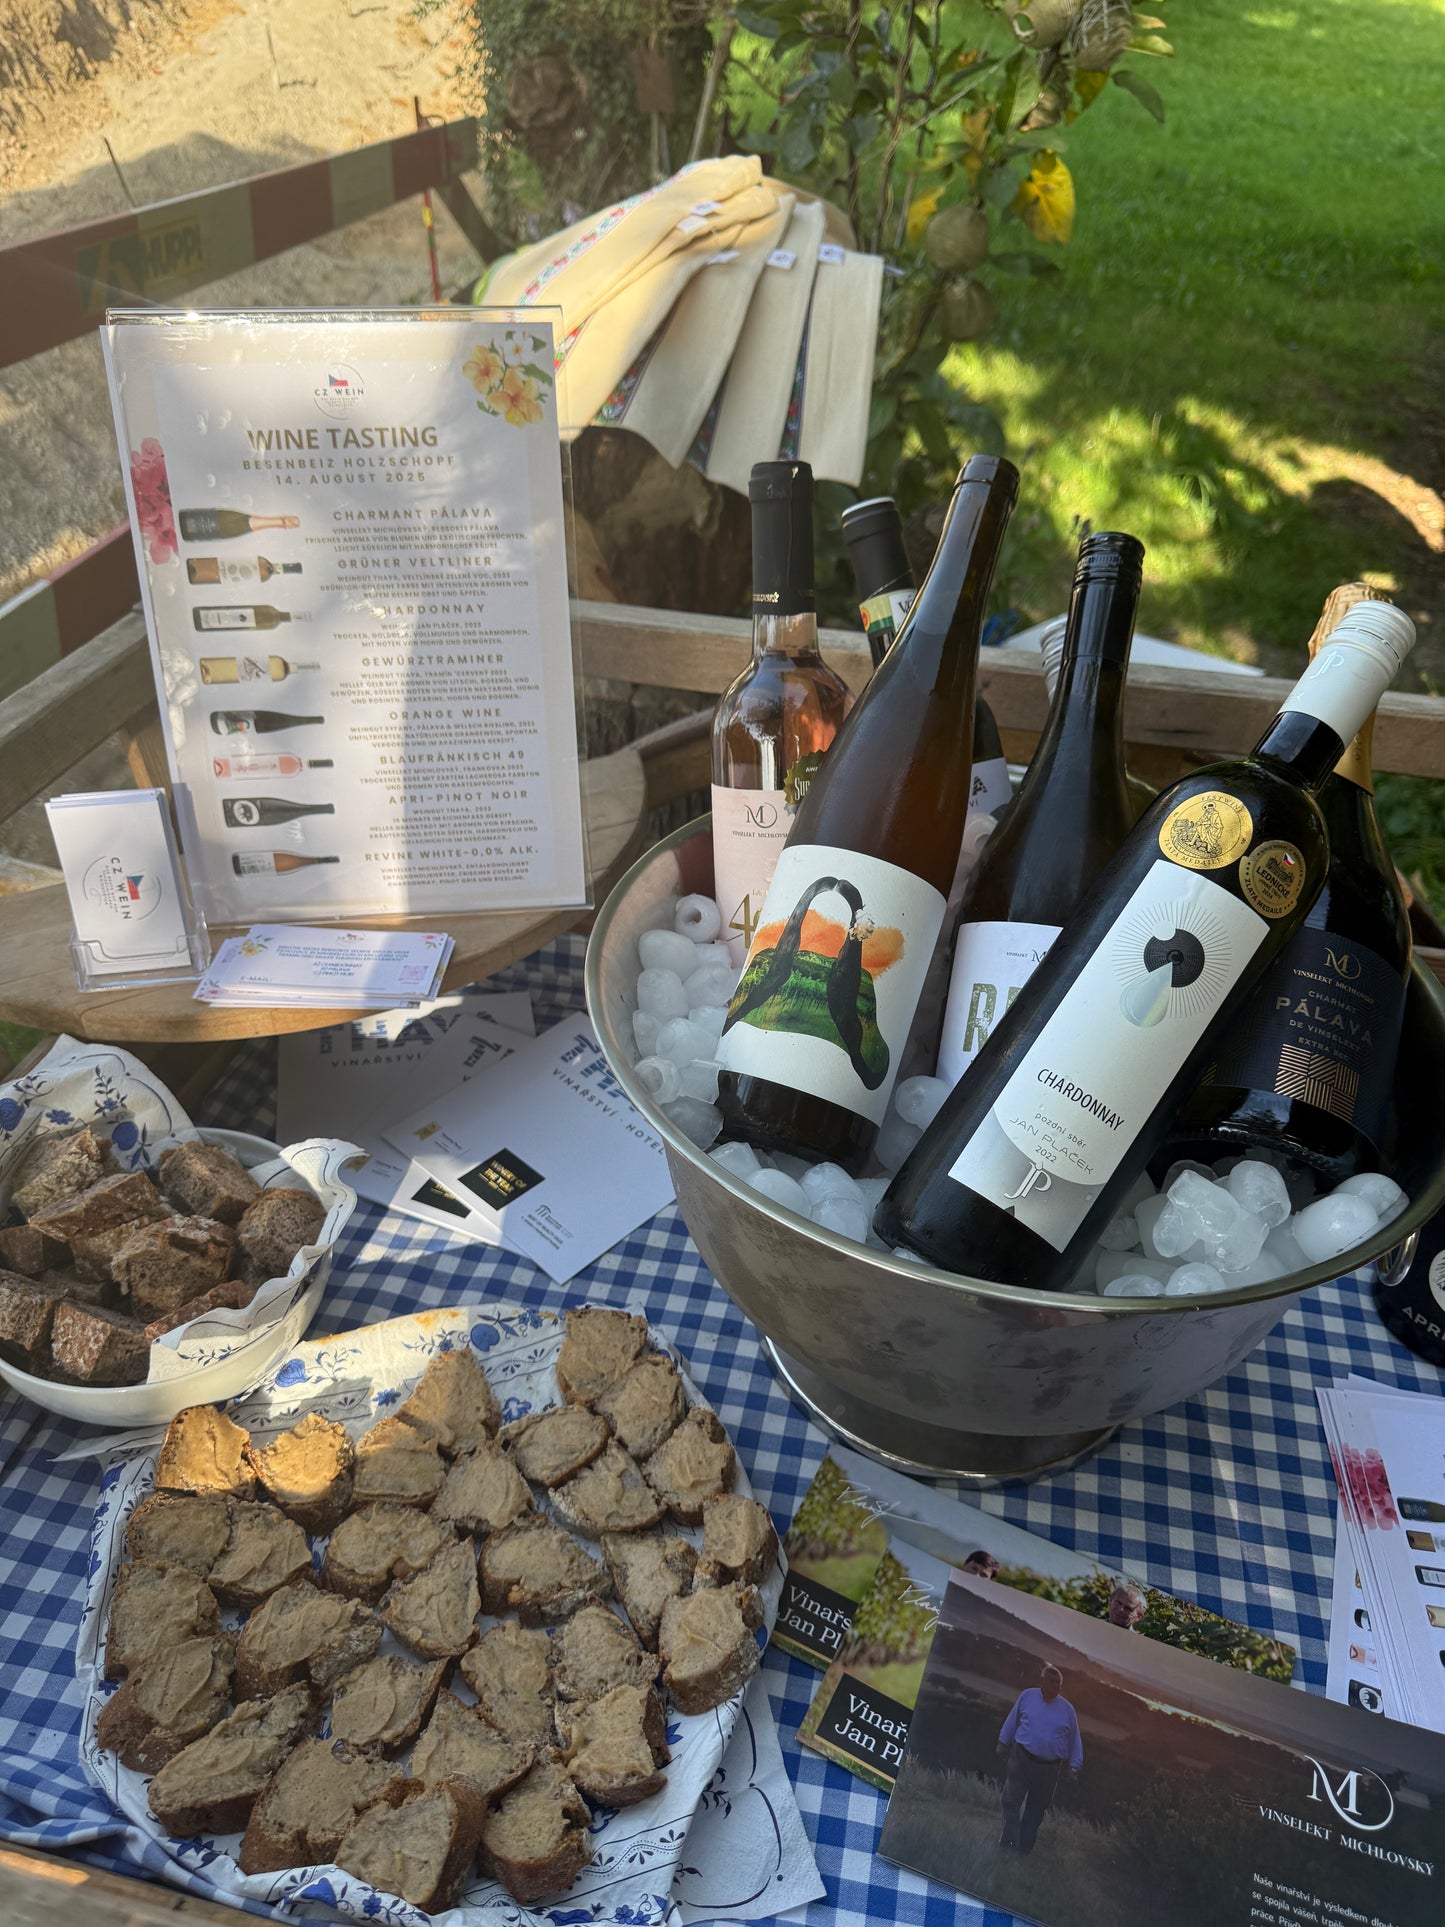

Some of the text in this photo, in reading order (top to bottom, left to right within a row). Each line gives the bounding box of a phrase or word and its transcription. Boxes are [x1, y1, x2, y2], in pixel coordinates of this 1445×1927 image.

[335, 388, 364, 396] WEIN
[247, 426, 438, 451] WINE TASTING
[243, 456, 455, 470] BESENBEIZ HOLZSCHOPF
[310, 473, 376, 484] AUGUST
[386, 472, 426, 482] 2025
[333, 507, 492, 520] CHARMANT PÁLAVA
[338, 557, 492, 568] GRÜNER VELTLINER
[362, 653, 504, 666] GEWÜRZTRAMINER
[389, 709, 502, 719] ORANGE WINE
[379, 749, 525, 764] BLAUFRÄNKISCH 49
[388, 790, 529, 804] APRI-PINOT NOIR
[365, 851, 413, 861] REVINE
[510, 846, 539, 855] ALK.
[111, 857, 132, 920] CZ WEIN
[1256, 866, 1290, 899] LEDNICKÉ
[1244, 878, 1257, 902] ZLATÁ
[1256, 900, 1283, 914] MEDAILE
[1292, 968, 1334, 985] VINSELEKT
[1276, 996, 1373, 1048] PÁLAVA
[1288, 1020, 1360, 1052] DE VINSELEKT
[1298, 1036, 1330, 1053] EXTRA
[331, 1052, 422, 1067] VINAŘSTVÍ
[552, 1067, 619, 1118] VINAŘSTVÍ
[626, 1123, 666, 1155] HOTEL
[1036, 1068, 1125, 1132] CHARDONNAY
[1009, 1118, 1094, 1175] JAN PLAČEK
[1034, 1145, 1058, 1164] 2022
[778, 1607, 815, 1637] Jan
[848, 1693, 909, 1743] Vinař
[834, 1718, 875, 1752] Jan
[1259, 1805, 1434, 1876] VINSELEKT MICHLOVSKÝ
[1252, 1872, 1273, 1888] Naše
[1312, 1896, 1321, 1906] je
[1324, 1900, 1368, 1924] výsledkem
[1252, 1890, 1262, 1900] se
[1264, 1894, 1290, 1912] spojila
